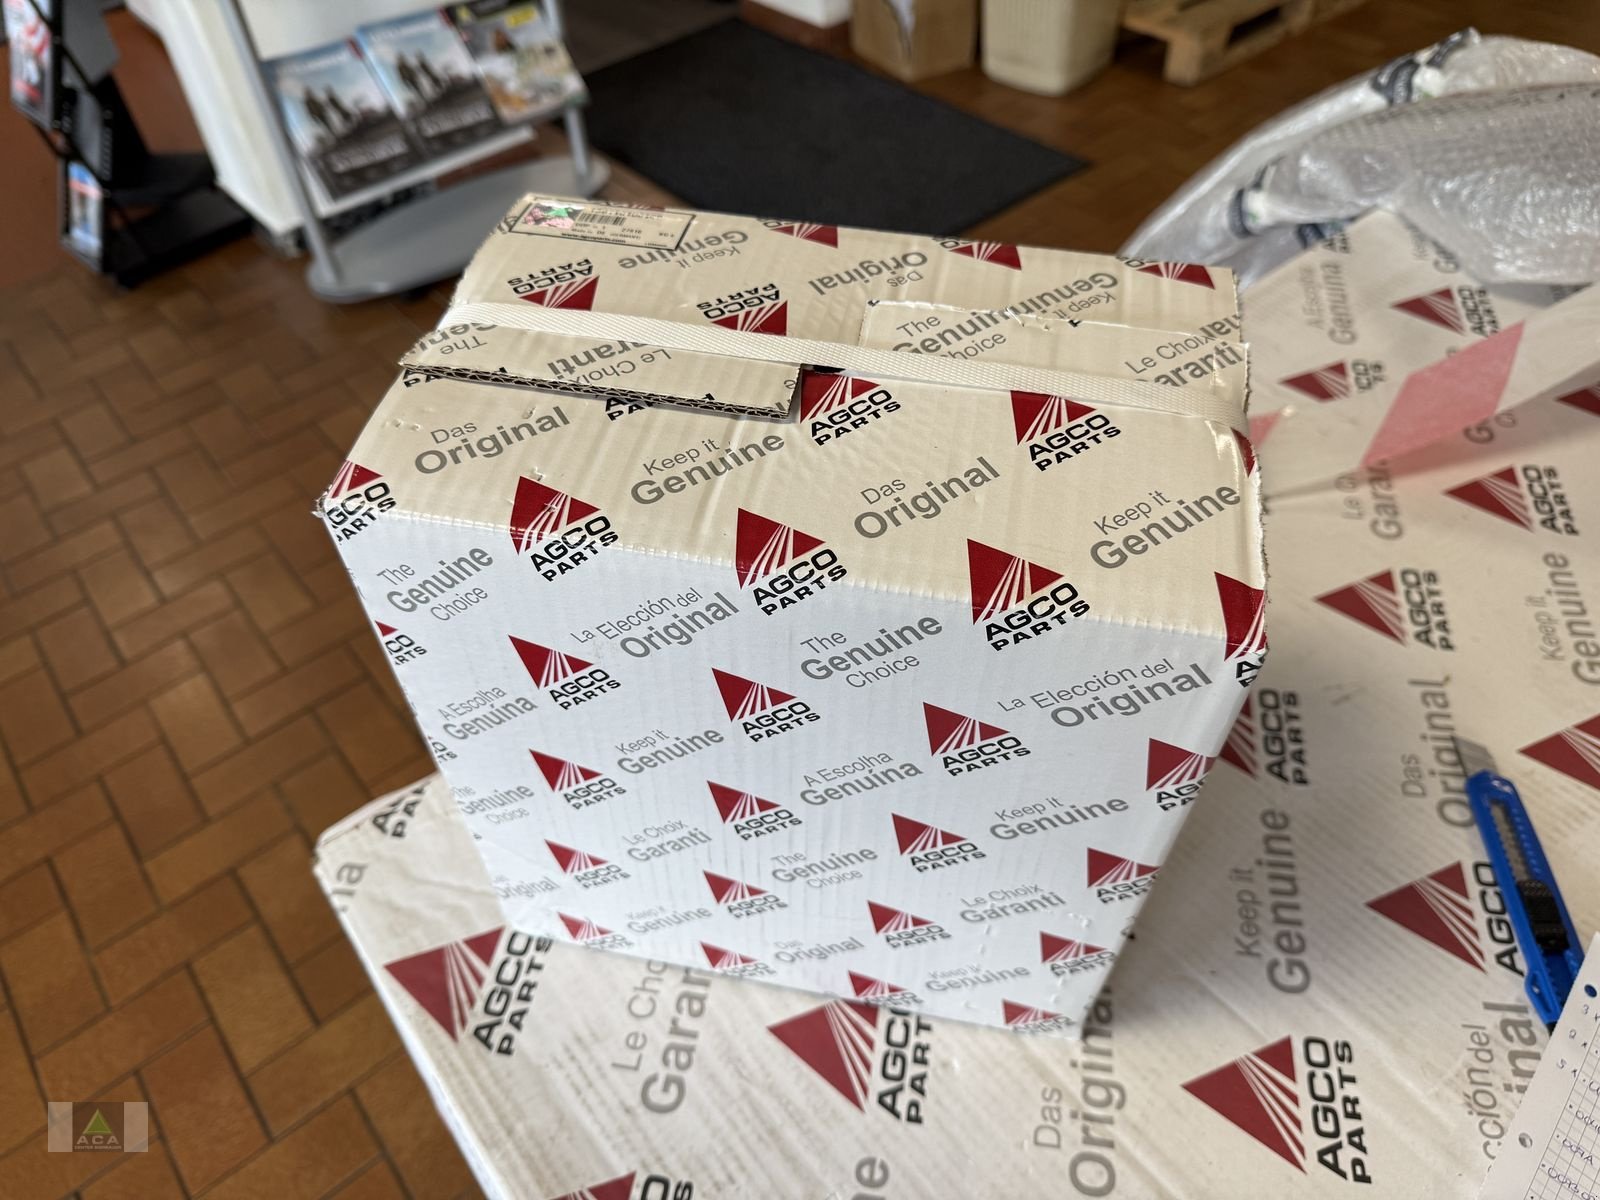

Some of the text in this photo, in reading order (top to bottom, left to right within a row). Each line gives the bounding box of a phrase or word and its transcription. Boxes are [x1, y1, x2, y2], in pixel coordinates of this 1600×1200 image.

[618, 231, 749, 270] Genuine
[692, 245, 742, 264] Keep
[506, 258, 593, 287] PARTS
[512, 264, 595, 295] AGCO
[808, 251, 929, 296] Original
[888, 269, 924, 288] Das
[695, 283, 777, 310] PARTS
[702, 288, 781, 320] AGCO
[1067, 291, 1117, 315] Keep
[439, 334, 488, 355] The
[896, 315, 941, 338] The
[637, 347, 672, 365] Le
[1125, 350, 1157, 375] Le
[430, 419, 478, 445] Das
[809, 387, 894, 439] AGCO
[813, 397, 902, 448] PARTS
[414, 405, 571, 476] Original
[641, 438, 722, 477] Keep it
[1027, 413, 1112, 463] AGCO
[1033, 423, 1122, 473] PARTS
[630, 431, 786, 506] Genuine
[326, 481, 391, 530] GCO
[853, 455, 1001, 540] Original
[860, 475, 907, 506] Das
[1521, 464, 1563, 535] AGCO
[1543, 466, 1580, 537] PARTS
[1088, 482, 1242, 570] Genuine
[1092, 488, 1171, 536] Keep it
[528, 514, 613, 572] AGCO
[541, 530, 620, 583] PARTS
[376, 561, 416, 587] The
[386, 547, 494, 614] Genuine
[750, 547, 839, 606] AGCO
[761, 563, 848, 617] PARTS
[430, 583, 489, 623] Choice
[569, 586, 705, 646] La Elección del
[983, 581, 1079, 643] AGCO
[1401, 567, 1437, 649] AGCO
[1422, 570, 1456, 652] PARTS
[1543, 552, 1600, 686] Genuine
[618, 591, 741, 660] Original
[800, 628, 848, 655] The
[990, 599, 1091, 652] PARTS
[800, 614, 944, 682] Genuine
[548, 667, 611, 703] AGCO
[844, 653, 922, 690] Choice
[997, 657, 1175, 714] La Elección del
[438, 685, 508, 721] A Escolha
[559, 676, 622, 711] PARTS
[1049, 663, 1213, 730] Original
[741, 700, 812, 736] AGCO
[748, 708, 821, 744] PARTS
[1259, 688, 1292, 784] AGCO
[614, 727, 671, 757] Keep it
[616, 726, 725, 776] Genuine
[941, 735, 1024, 772] AGCO
[1282, 691, 1310, 786] PARTS
[802, 749, 894, 789] A Escolha
[947, 743, 1032, 778] PARTS
[1401, 753, 1427, 798] Das
[562, 776, 618, 804] AGCO
[570, 785, 628, 811] PARTS
[993, 795, 1064, 823] Keep it
[622, 819, 688, 848] Le Choix
[732, 808, 795, 837] AGCO
[740, 816, 803, 842] PARTS
[988, 797, 1131, 842] Genuine
[626, 827, 713, 864] Garanti
[771, 844, 879, 885] Genuine
[772, 850, 807, 867] The
[908, 841, 979, 868] AGCO
[915, 849, 988, 875] PARTS
[573, 863, 623, 884] AGCO
[581, 870, 632, 890] PARTS
[805, 867, 863, 891] Choice
[726, 893, 782, 914] AGCO
[733, 900, 789, 919] PARTS
[959, 881, 1044, 909] Le Choix
[959, 890, 1067, 925] Garanti
[1229, 864, 1264, 961] Keep it
[1256, 809, 1312, 995] Genuine
[626, 905, 713, 935] Genuine
[883, 923, 946, 946] AGCO
[1472, 860, 1525, 978] AGCO
[773, 936, 865, 966] Original
[890, 931, 953, 949] PARTS
[473, 932, 535, 1050] AGCO
[497, 936, 554, 1057] PARTS
[924, 964, 1031, 993] Genuine
[611, 1030, 648, 1072] Le
[1461, 1023, 1495, 1064] del
[877, 1008, 911, 1121] AGC
[906, 1014, 933, 1126] PART
[1034, 1086, 1063, 1150] Das
[1304, 1035, 1348, 1181] AGCO
[1335, 1039, 1373, 1185] PARTS
